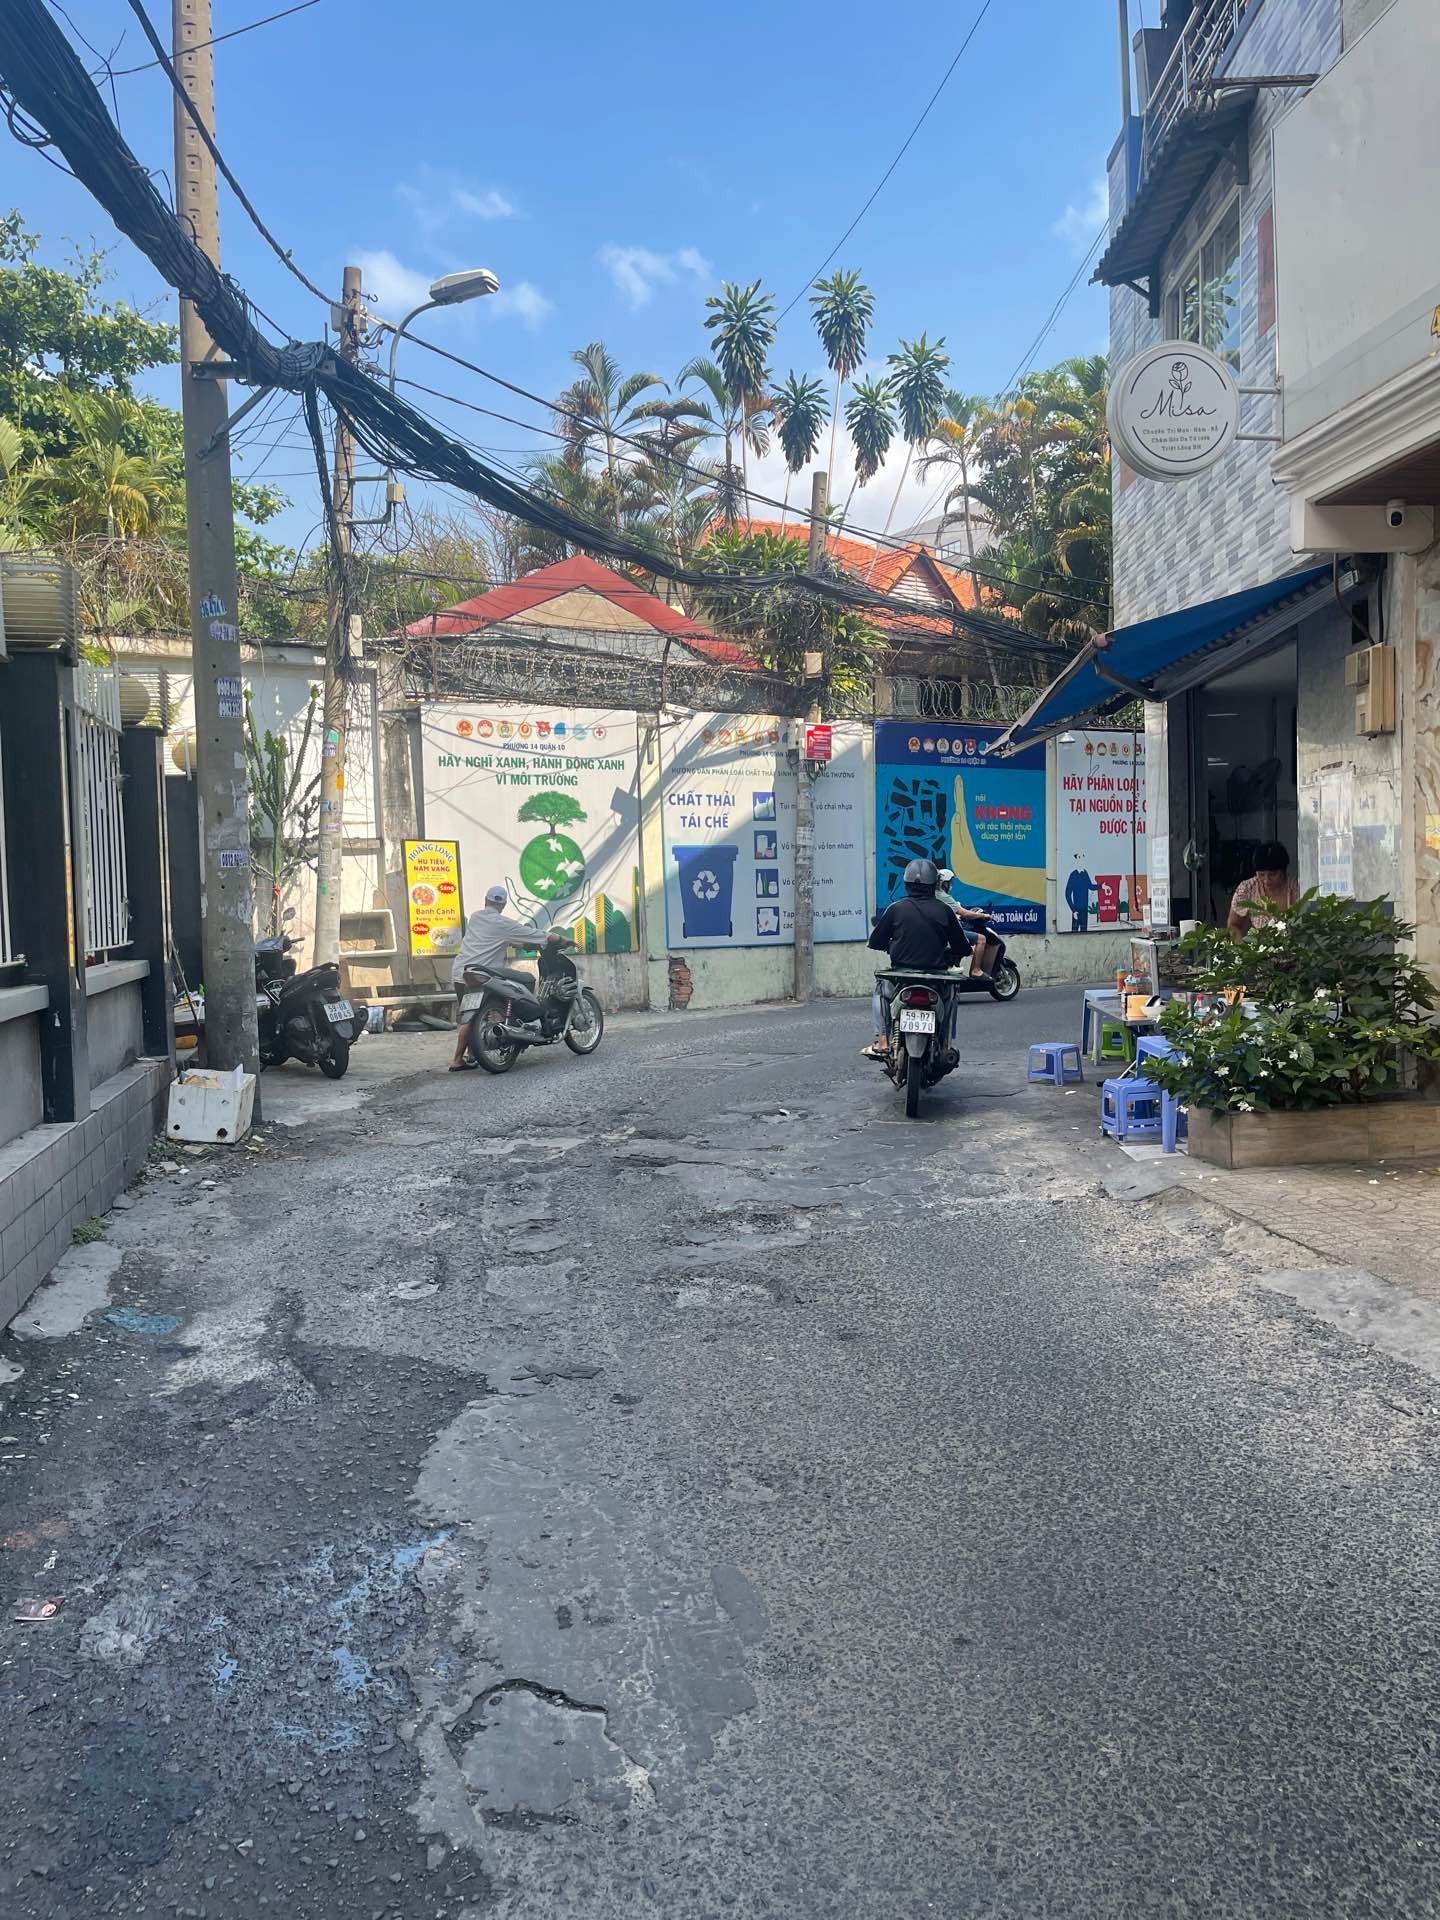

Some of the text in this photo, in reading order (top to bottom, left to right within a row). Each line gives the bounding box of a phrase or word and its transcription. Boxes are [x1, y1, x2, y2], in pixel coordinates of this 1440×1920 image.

[1140, 389, 1217, 420] Misa
[438, 753, 461, 767] HÃY
[465, 754, 493, 768] NGHĨ
[496, 757, 530, 770] XANH,
[565, 756, 594, 772] ĐỘNG
[598, 759, 625, 770] XANH
[496, 771, 578, 786] VÌ MÔI TRƯỜNG
[1063, 773, 1083, 790] HÃY
[1087, 774, 1114, 791] PHÂN
[668, 790, 736, 807] CHẤT THẢI
[1069, 799, 1086, 815] TẠI
[1089, 793, 1123, 812] NGUỒN
[680, 811, 729, 828] TÁI CHẾ
[1100, 818, 1128, 837] ĐƯỢC
[1006, 910, 1023, 923] TOÀN
